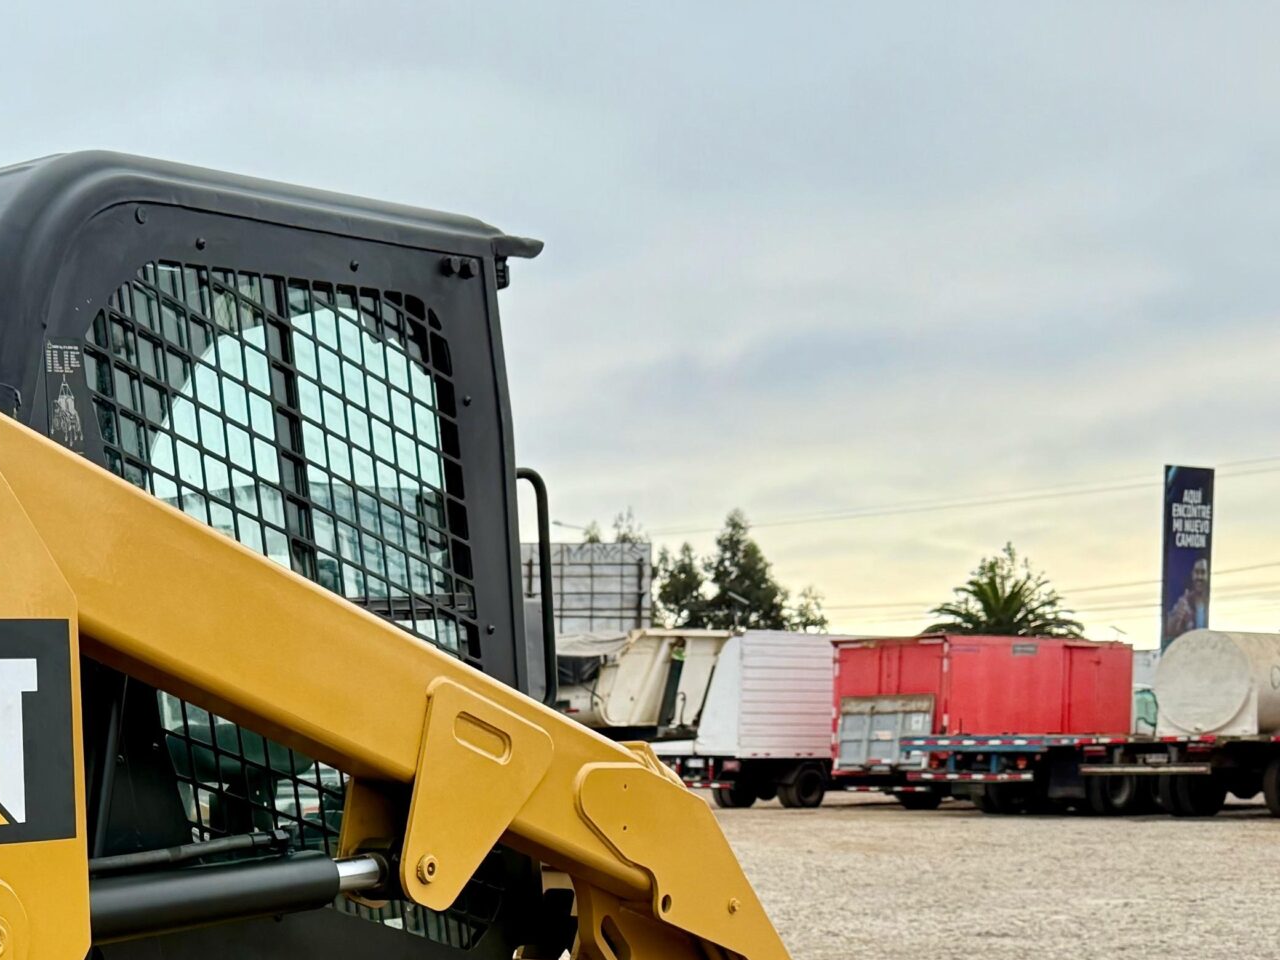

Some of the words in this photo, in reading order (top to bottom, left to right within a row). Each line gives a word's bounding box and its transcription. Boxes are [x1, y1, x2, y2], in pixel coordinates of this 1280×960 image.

[1182, 488, 1203, 504] AQUÍ
[1173, 518, 1183, 532] MI
[1184, 520, 1210, 534] NUEVO
